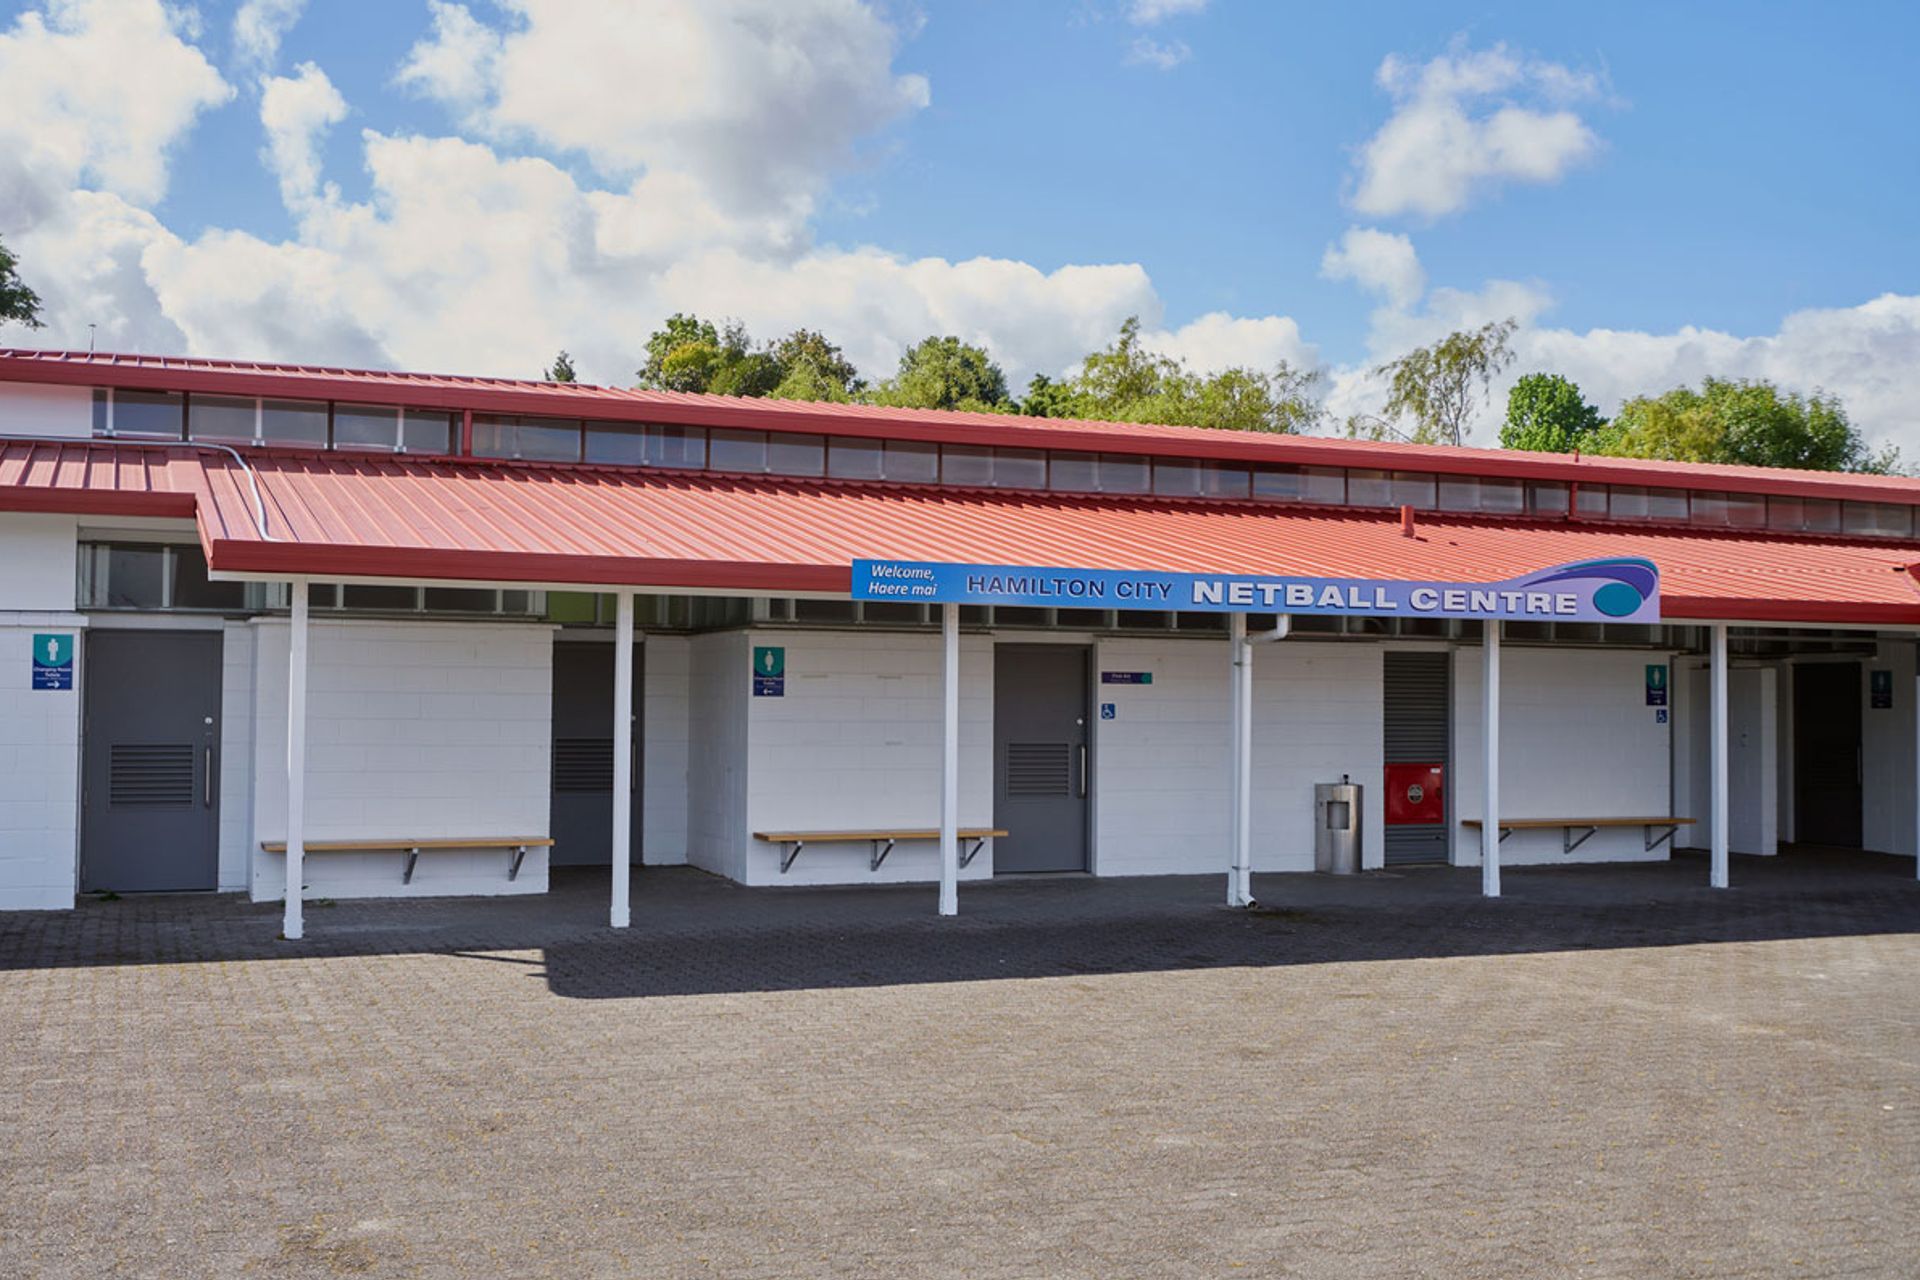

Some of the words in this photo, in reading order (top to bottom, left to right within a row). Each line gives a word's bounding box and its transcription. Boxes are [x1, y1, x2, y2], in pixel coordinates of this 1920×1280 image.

[871, 564, 935, 581] Welcome,
[868, 581, 909, 596] Haere
[911, 583, 938, 597] mai
[966, 574, 1105, 599] HAMILTON
[1116, 581, 1173, 599] CITY
[1191, 580, 1398, 609] NETBALL
[1408, 587, 1578, 615] CENTRE
